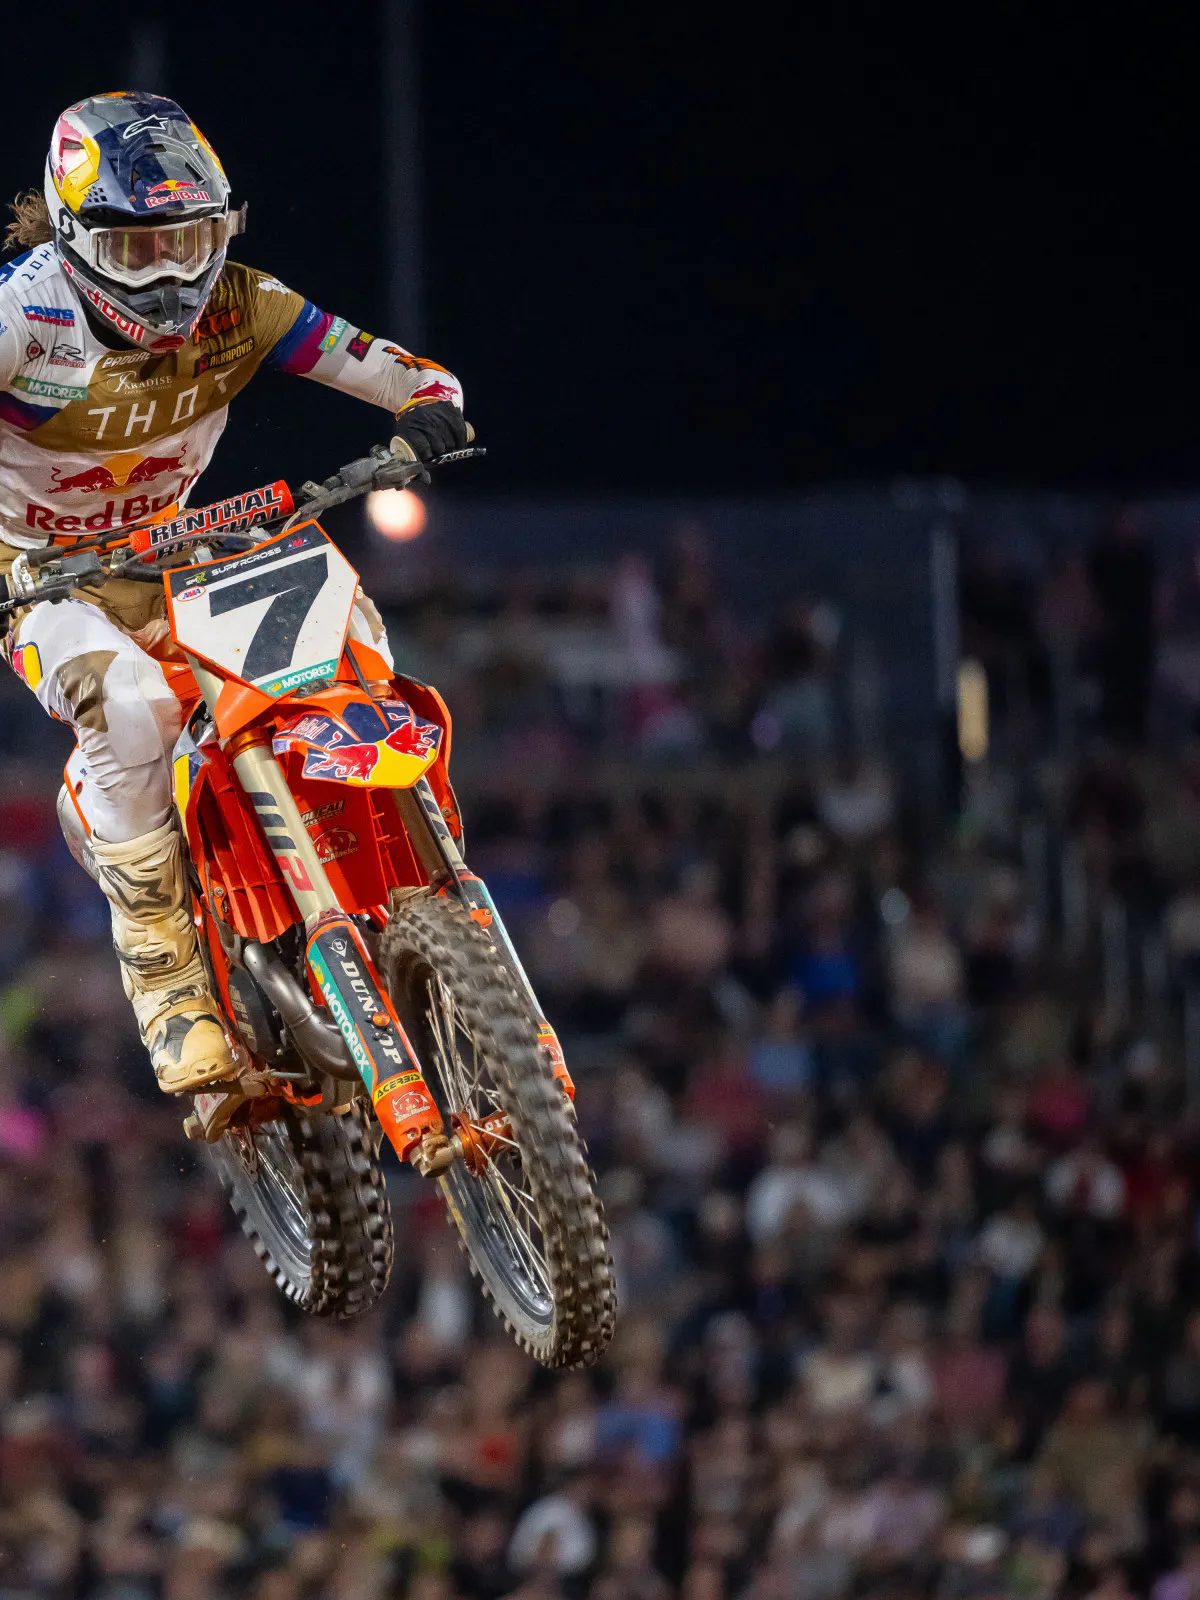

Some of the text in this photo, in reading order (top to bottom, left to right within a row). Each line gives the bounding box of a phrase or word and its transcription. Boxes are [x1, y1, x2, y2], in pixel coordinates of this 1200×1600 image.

[145, 191, 210, 208] Red Bull
[27, 382, 84, 398] MOTOREX
[26, 498, 114, 532] Red
[149, 487, 283, 546] RENTHAL
[211, 546, 282, 577] SUPERCROSS
[209, 552, 329, 682] 7
[281, 664, 334, 689] MOTOREX
[322, 983, 371, 1074] MOTOREX
[340, 960, 402, 1065] DUNOP
[377, 1073, 421, 1099] ACERBIS
